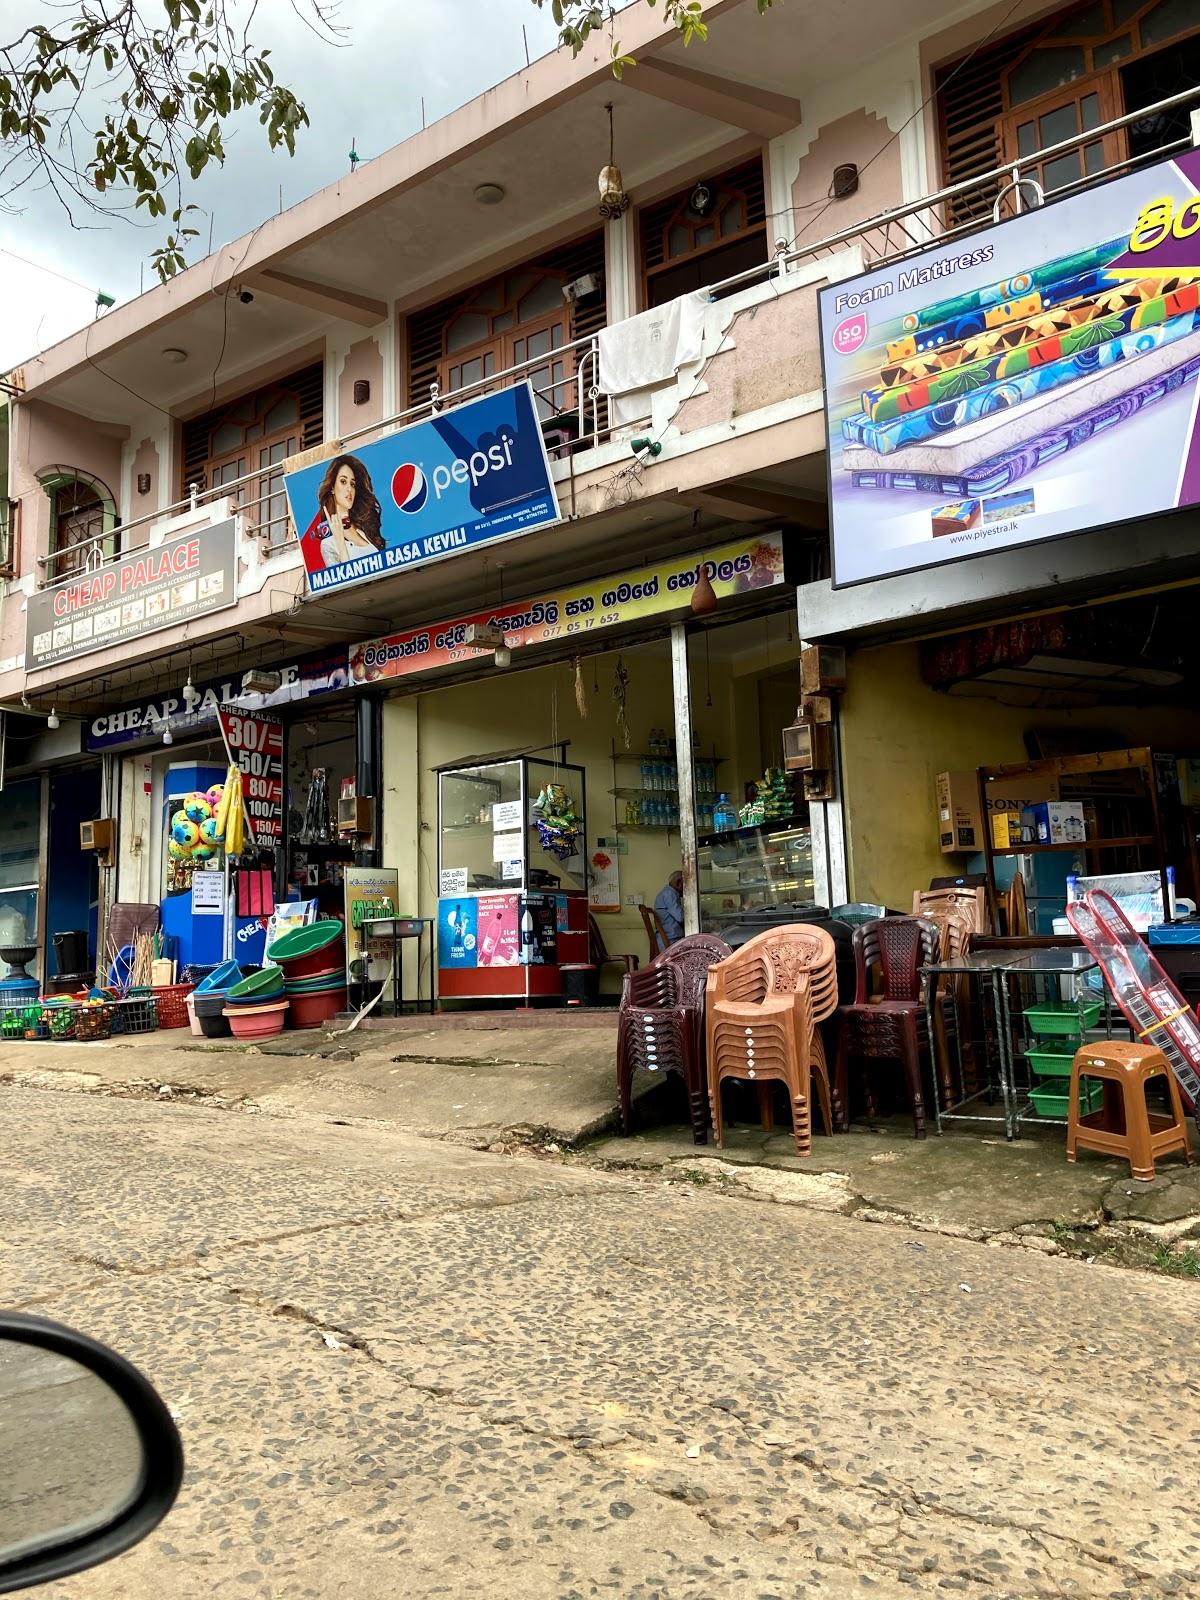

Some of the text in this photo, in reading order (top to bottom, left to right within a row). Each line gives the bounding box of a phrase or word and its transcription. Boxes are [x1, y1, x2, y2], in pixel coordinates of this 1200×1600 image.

[836, 244, 994, 314] Foam Mattress
[839, 325, 862, 341] ISO
[433, 435, 513, 499] pepsi
[950, 522, 1018, 544] www.piyestra.lk
[312, 527, 467, 589] MALKANTHI RASA KEVILI
[53, 538, 200, 617] CHEAP PALACE
[565, 595, 595, 617] සහ
[601, 576, 659, 607] ගමගේ
[542, 613, 620, 638] 077 05 17 652
[91, 664, 299, 737] CHEAP PALE
[220, 703, 281, 725] CHEAP PALACE
[228, 716, 282, 751] 30/=
[239, 749, 282, 778] 50/=
[249, 777, 282, 799] 80/=
[249, 800, 282, 819] 100/=
[255, 819, 282, 834] 150/=
[257, 834, 282, 847] 200/=
